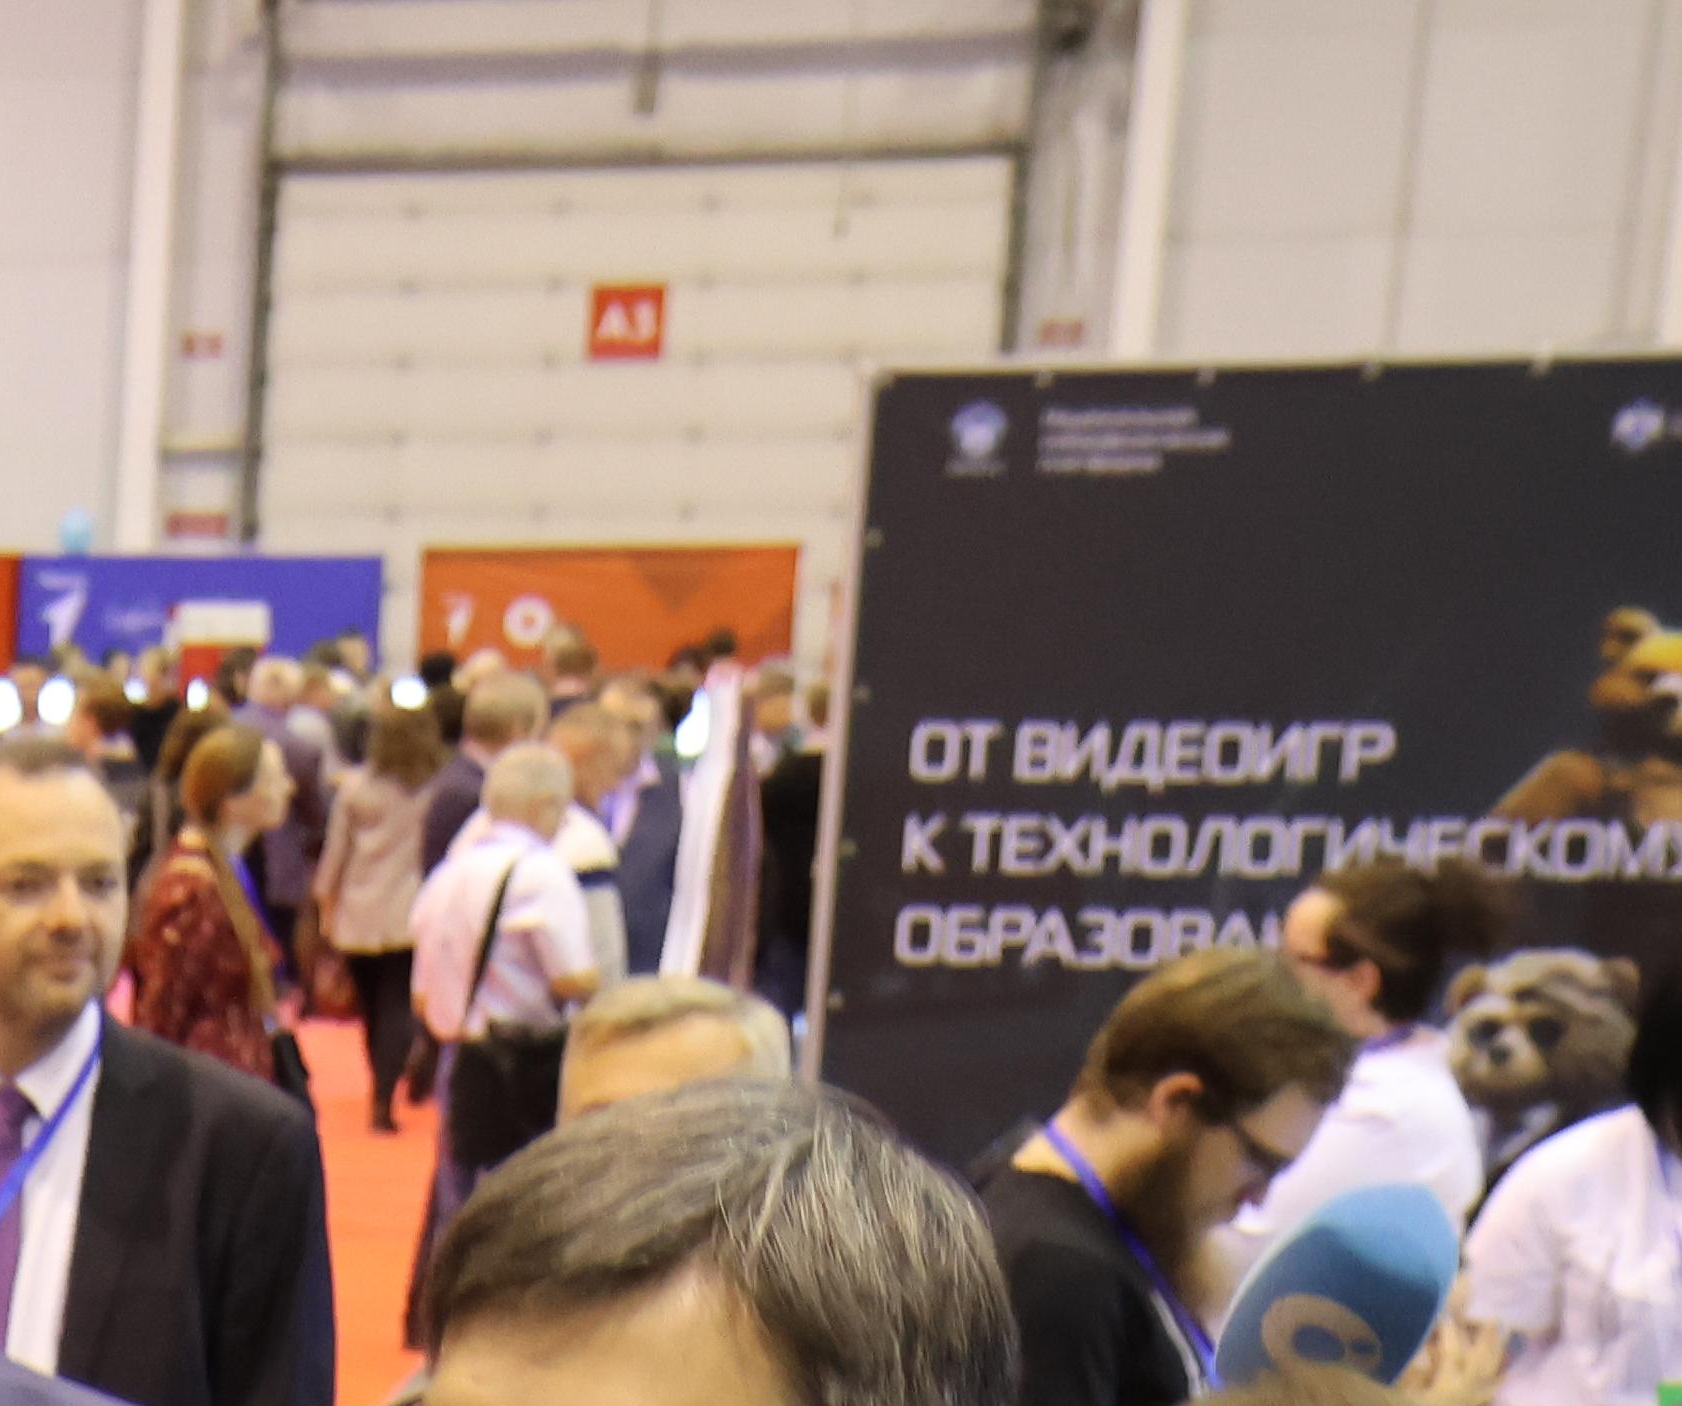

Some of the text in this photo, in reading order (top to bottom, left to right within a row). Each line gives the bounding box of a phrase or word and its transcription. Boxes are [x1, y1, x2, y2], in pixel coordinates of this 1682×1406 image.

[909, 717, 1398, 794] ОТ ВИДЕОИГР
[901, 811, 949, 876] К
[893, 902, 1284, 970] ОБРАЗОВА
